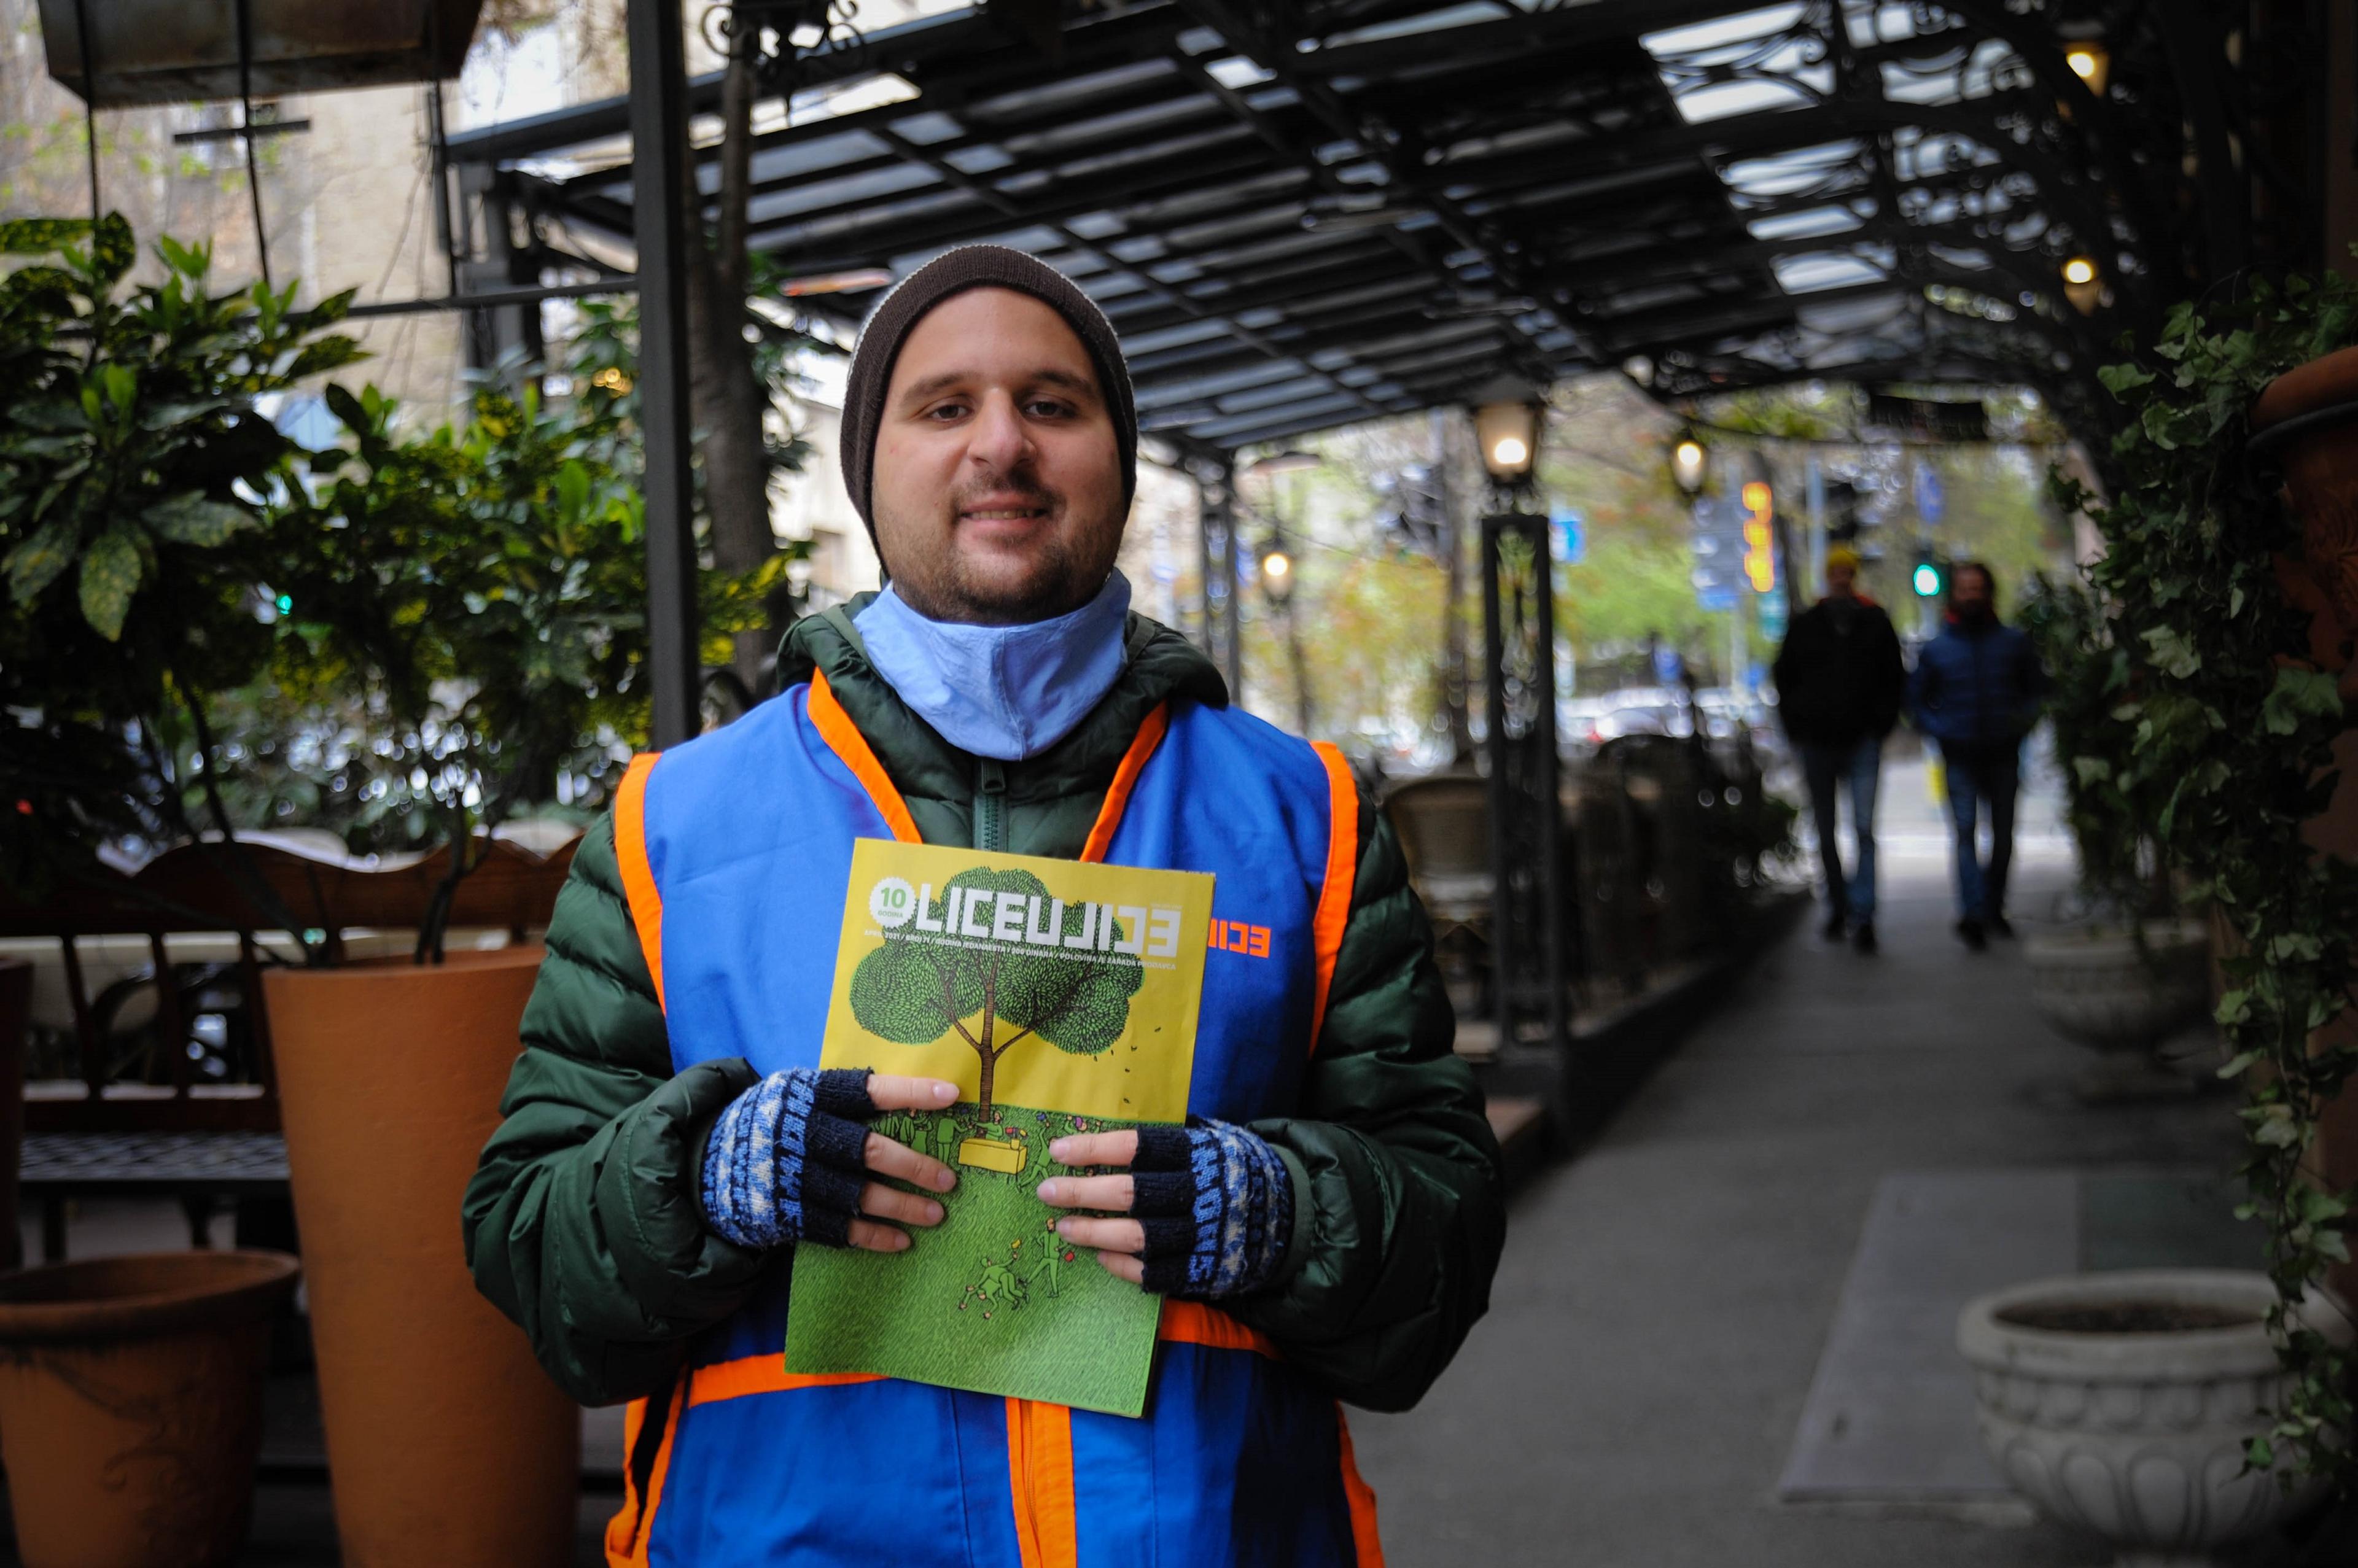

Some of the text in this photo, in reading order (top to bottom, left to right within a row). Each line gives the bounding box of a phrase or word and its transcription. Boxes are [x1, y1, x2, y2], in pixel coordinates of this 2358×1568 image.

[881, 887, 906, 909] 10
[935, 937, 962, 947] GODINA
[1026, 949, 1053, 958] DINARA
[1059, 952, 1096, 963] POLOVINA
[1107, 957, 1137, 966] ZARADA
